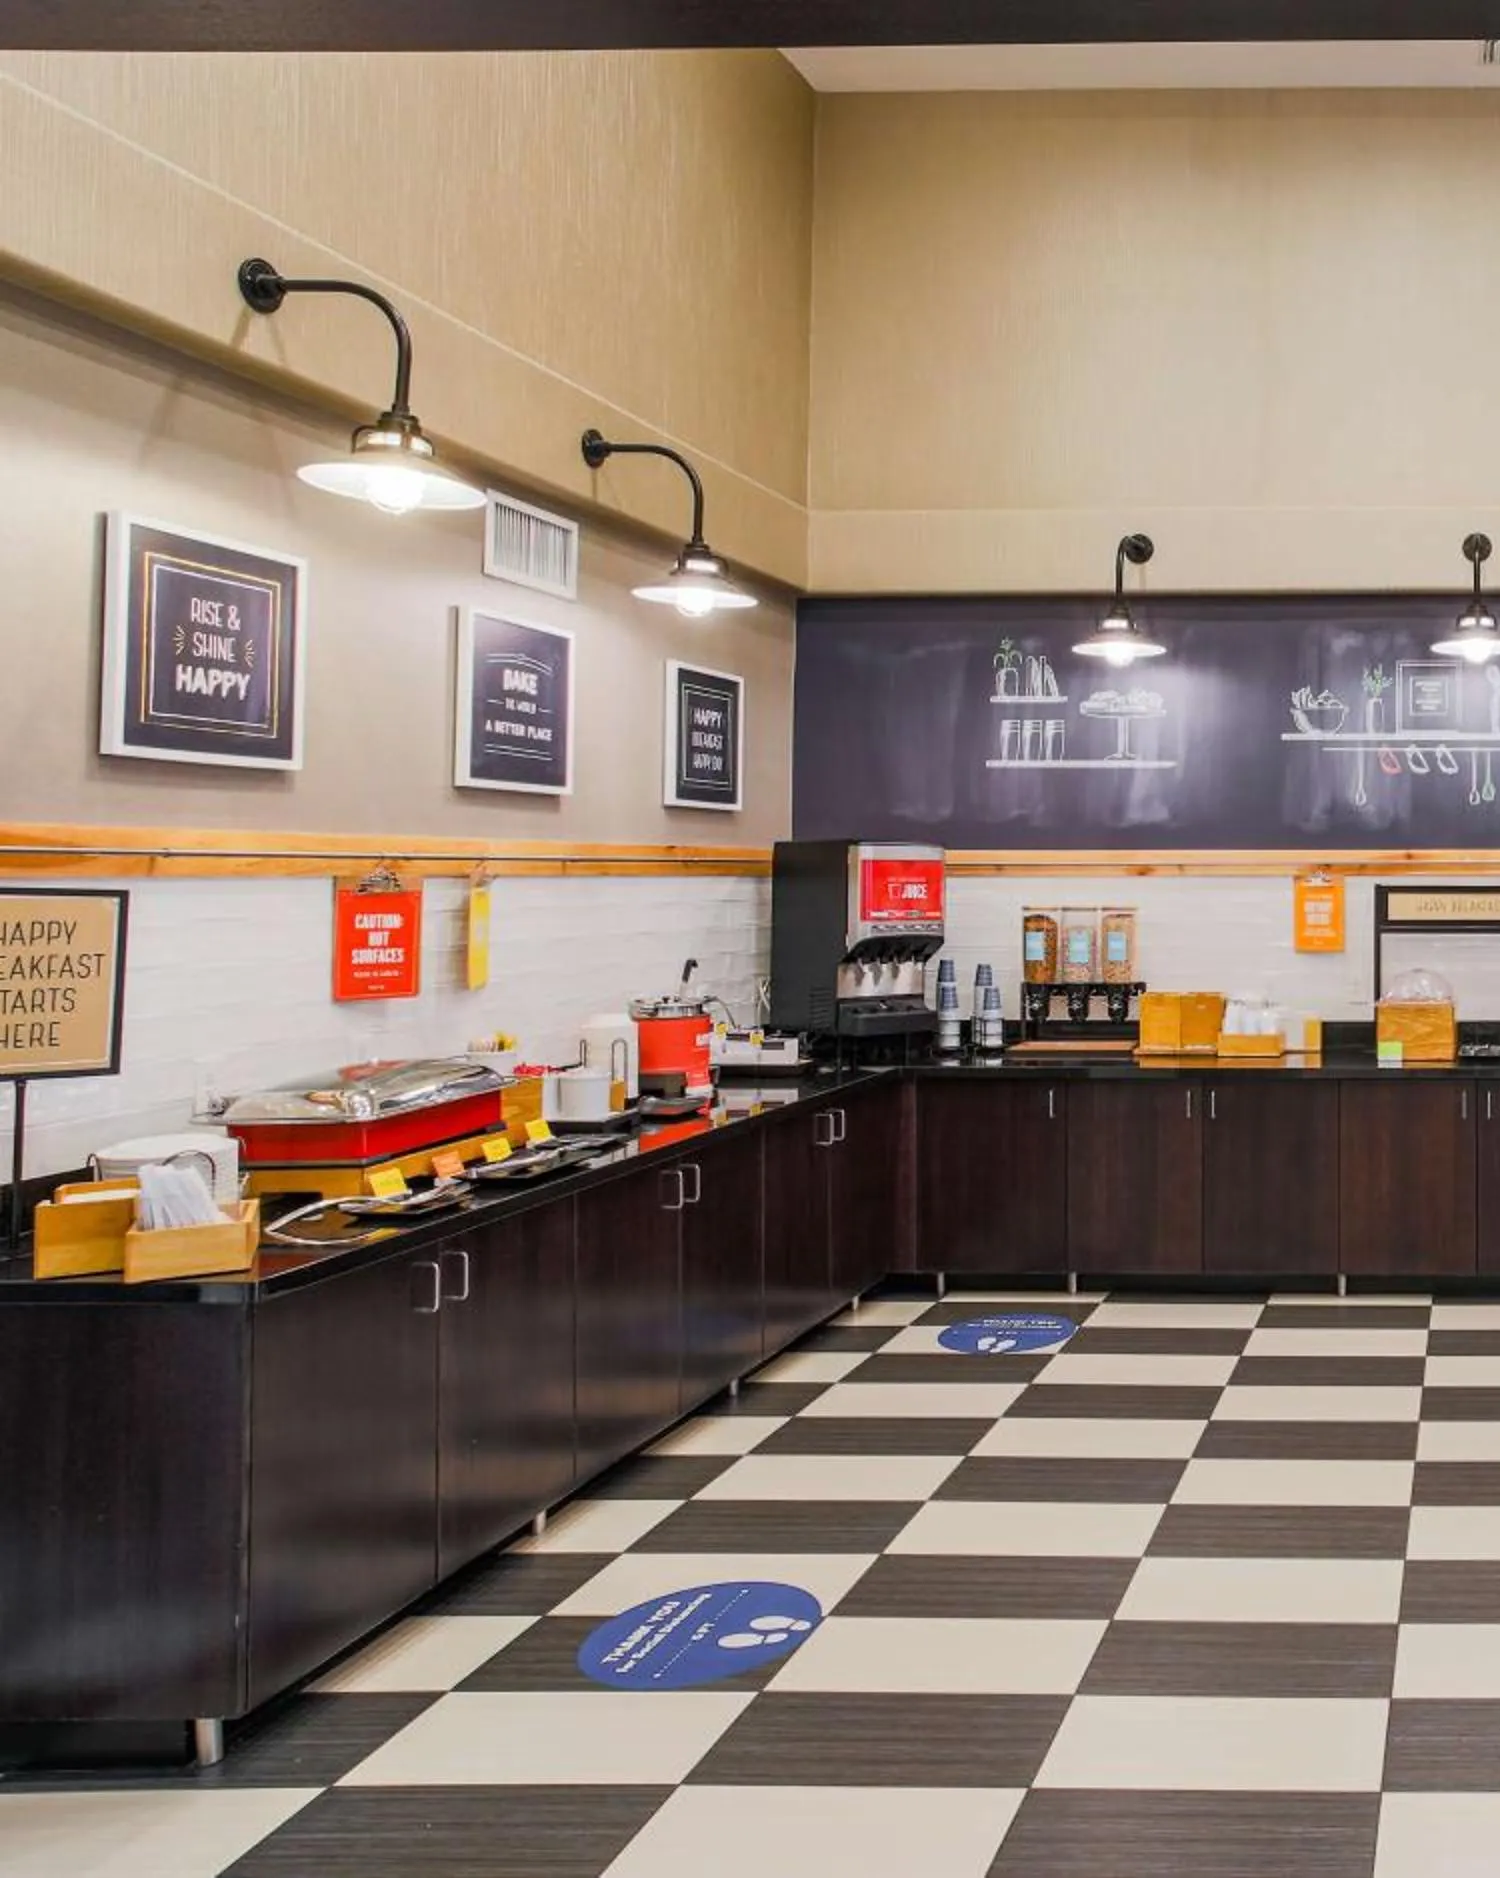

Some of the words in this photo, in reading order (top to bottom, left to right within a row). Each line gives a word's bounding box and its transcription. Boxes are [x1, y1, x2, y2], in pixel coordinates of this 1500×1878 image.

[190, 596, 225, 628] RISE
[227, 604, 241, 631] &
[192, 631, 237, 663] SHINE
[175, 663, 251, 701] HAPPY
[503, 669, 539, 695] BAKE
[485, 719, 493, 732] A
[352, 948, 404, 964] SURFACES
